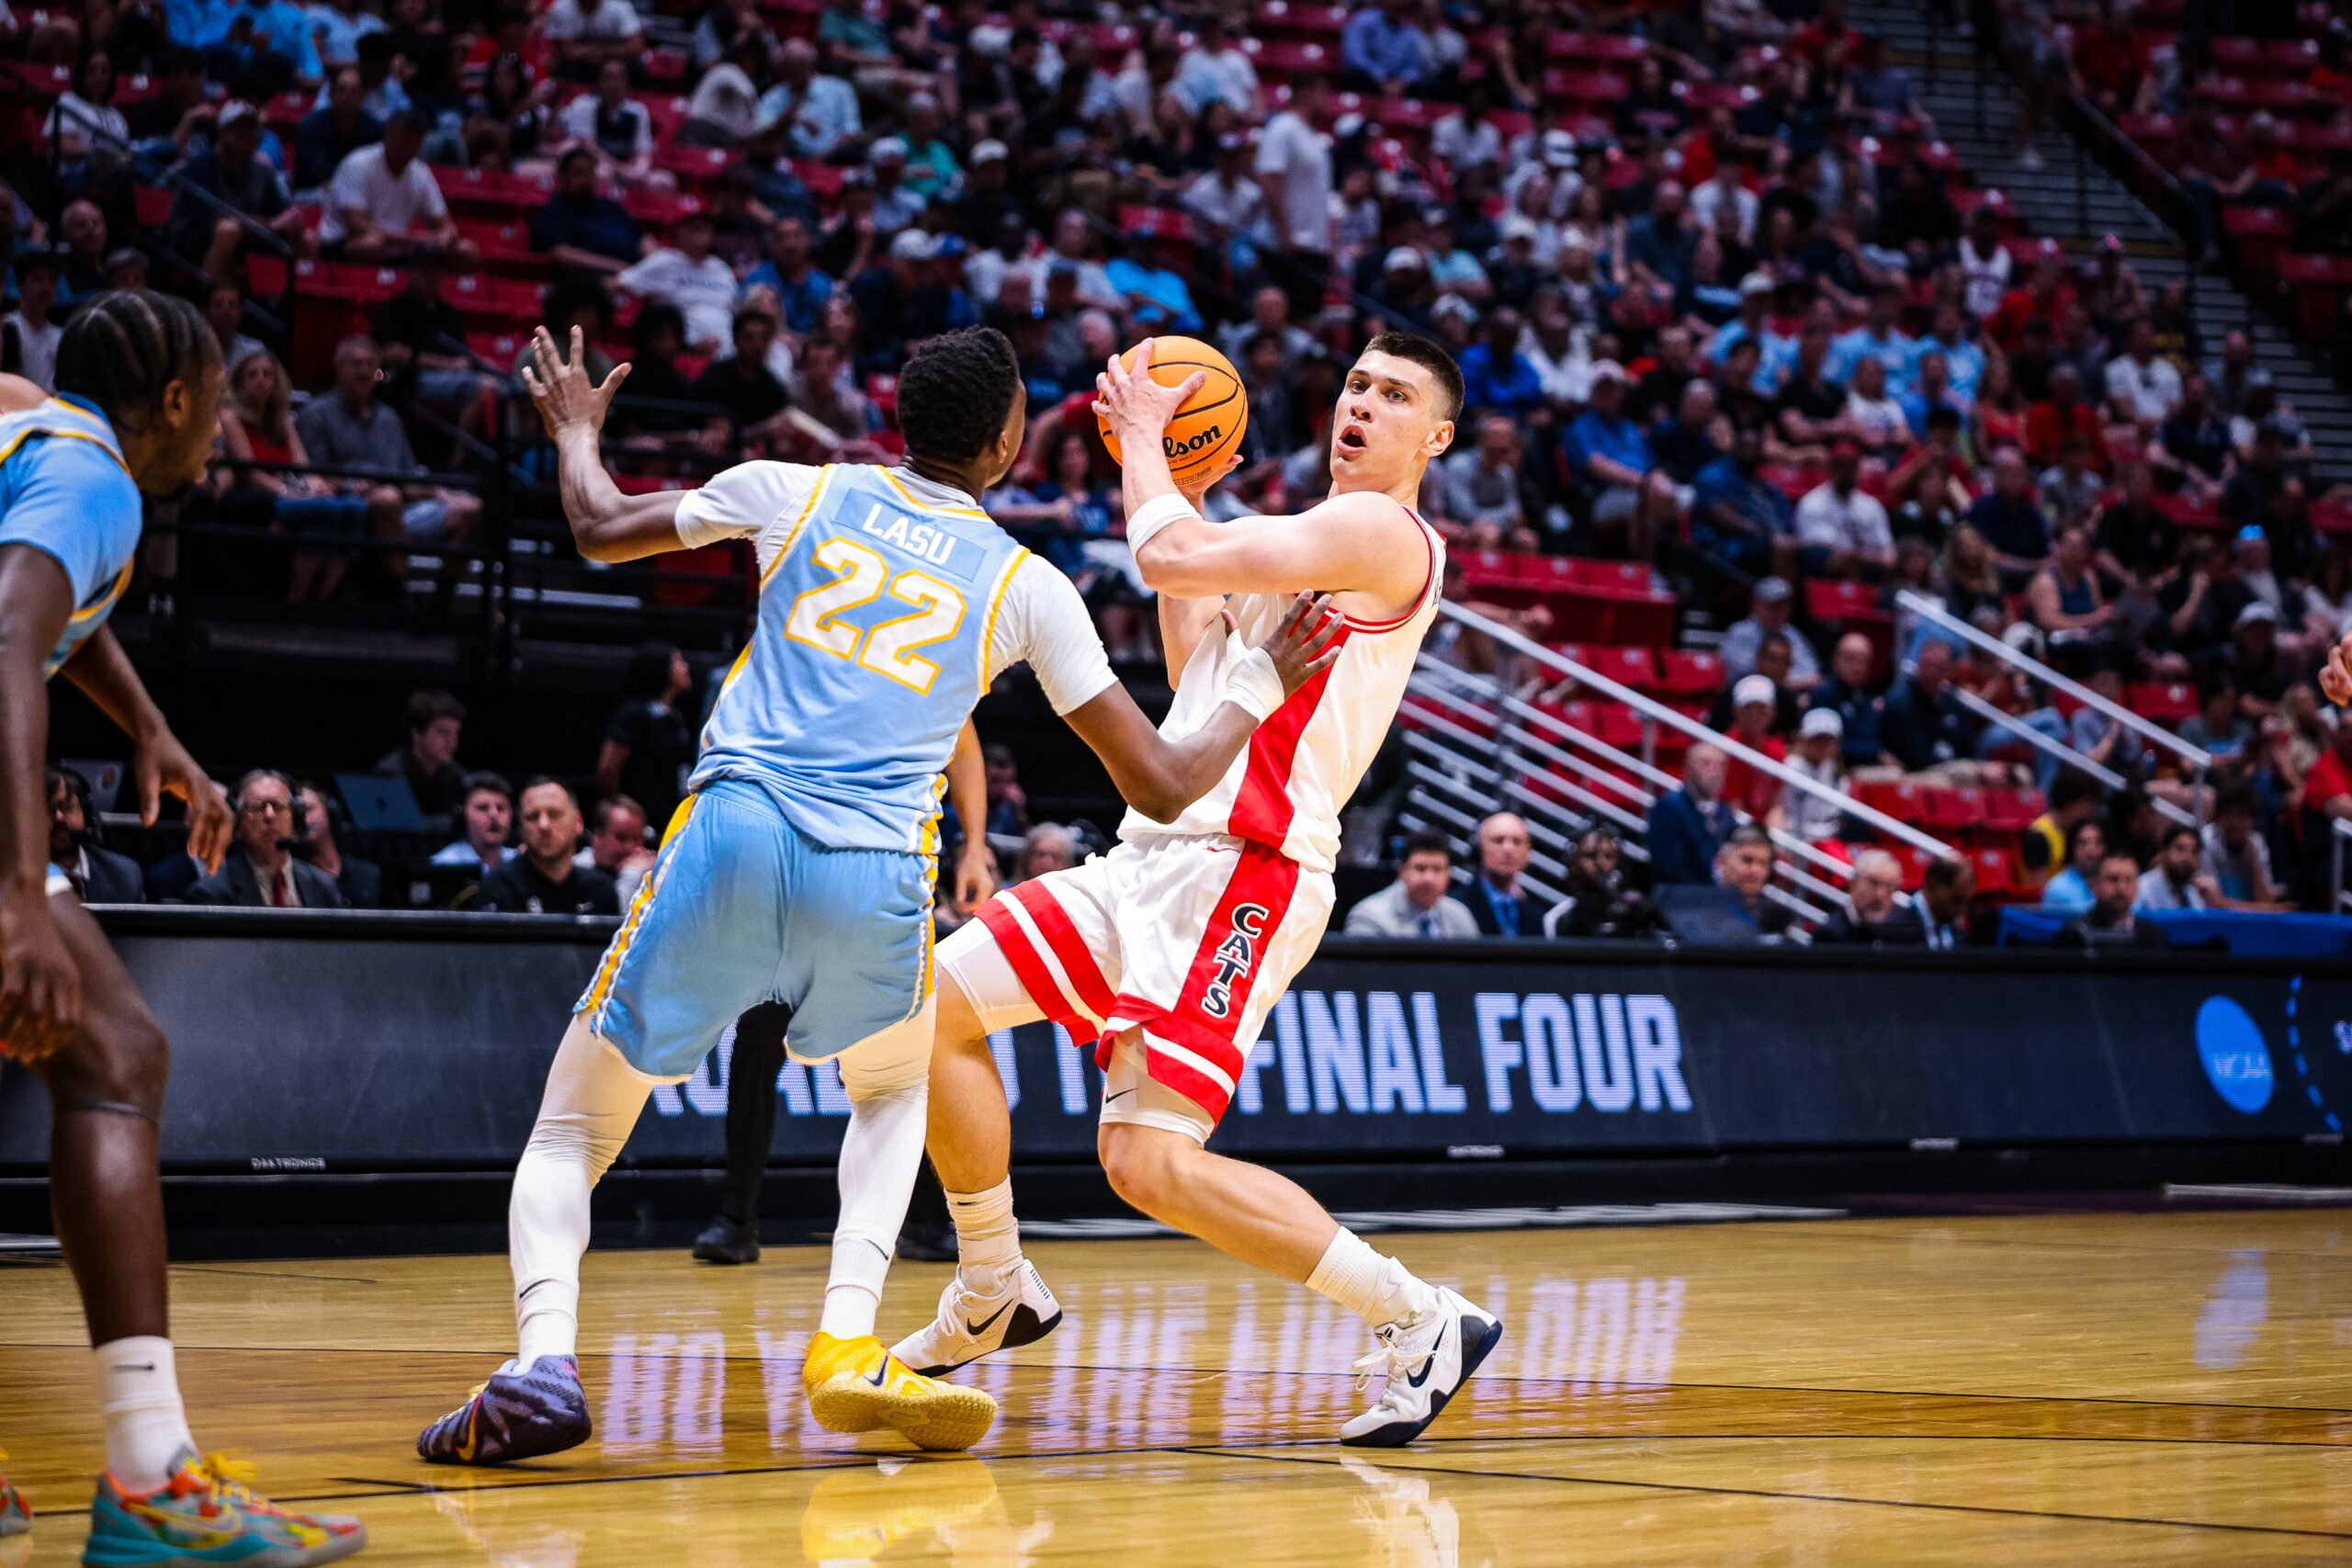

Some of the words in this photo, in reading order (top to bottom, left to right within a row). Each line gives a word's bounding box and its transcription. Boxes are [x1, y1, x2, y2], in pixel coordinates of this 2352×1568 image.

[1162, 424, 1222, 457] lson
[862, 502, 957, 566] LASU
[783, 536, 968, 697] 22
[1201, 902, 1271, 1019] CATS
[1475, 992, 1693, 1112] FOUR
